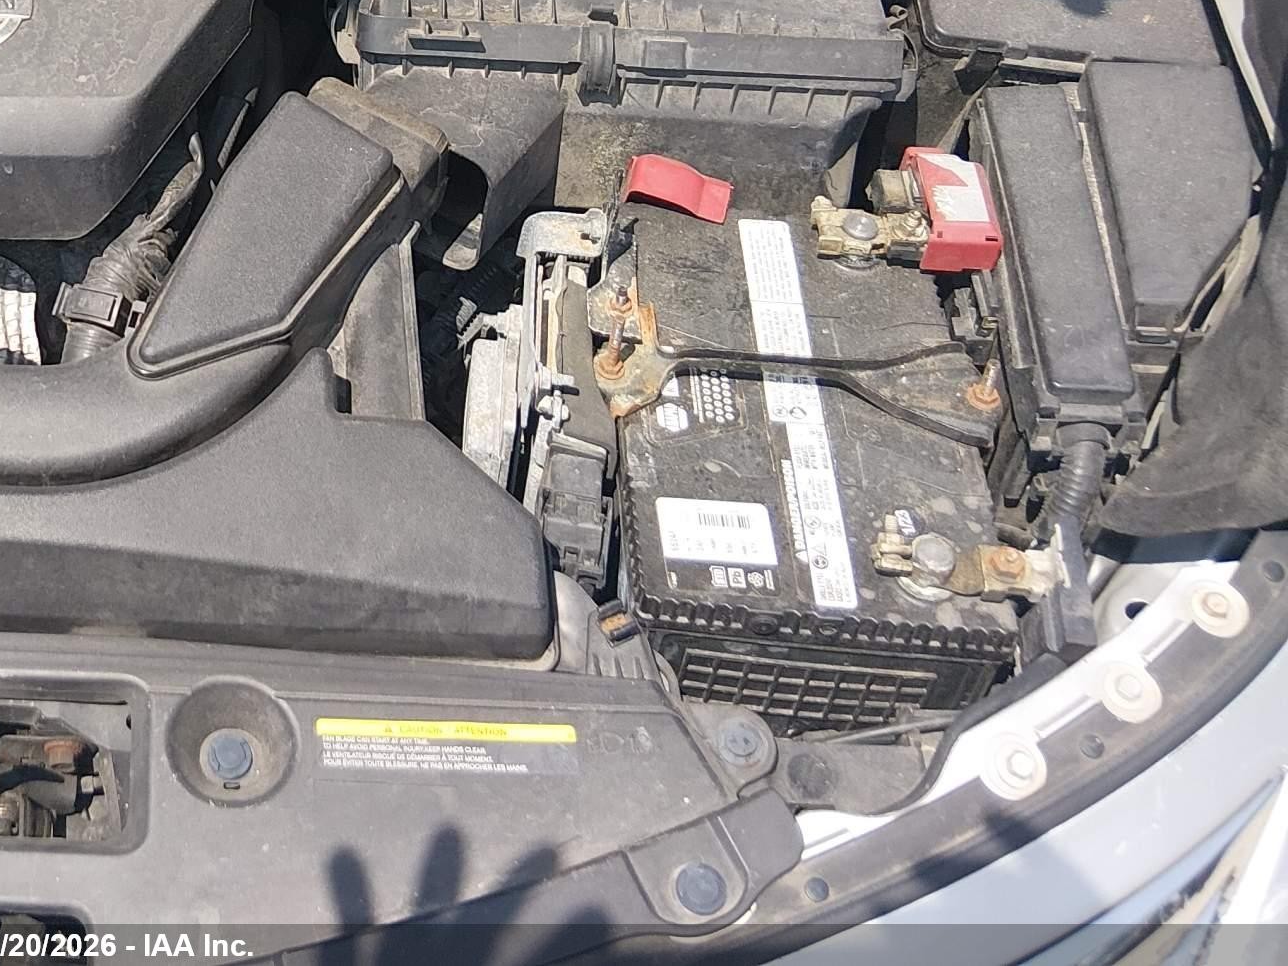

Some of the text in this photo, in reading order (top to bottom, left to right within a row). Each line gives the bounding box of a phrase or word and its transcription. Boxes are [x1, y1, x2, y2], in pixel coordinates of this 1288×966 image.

[781, 459, 806, 550] DANGER/POISON
[732, 571, 742, 585] Pb
[399, 725, 508, 736] CAUTION ATTENTION
